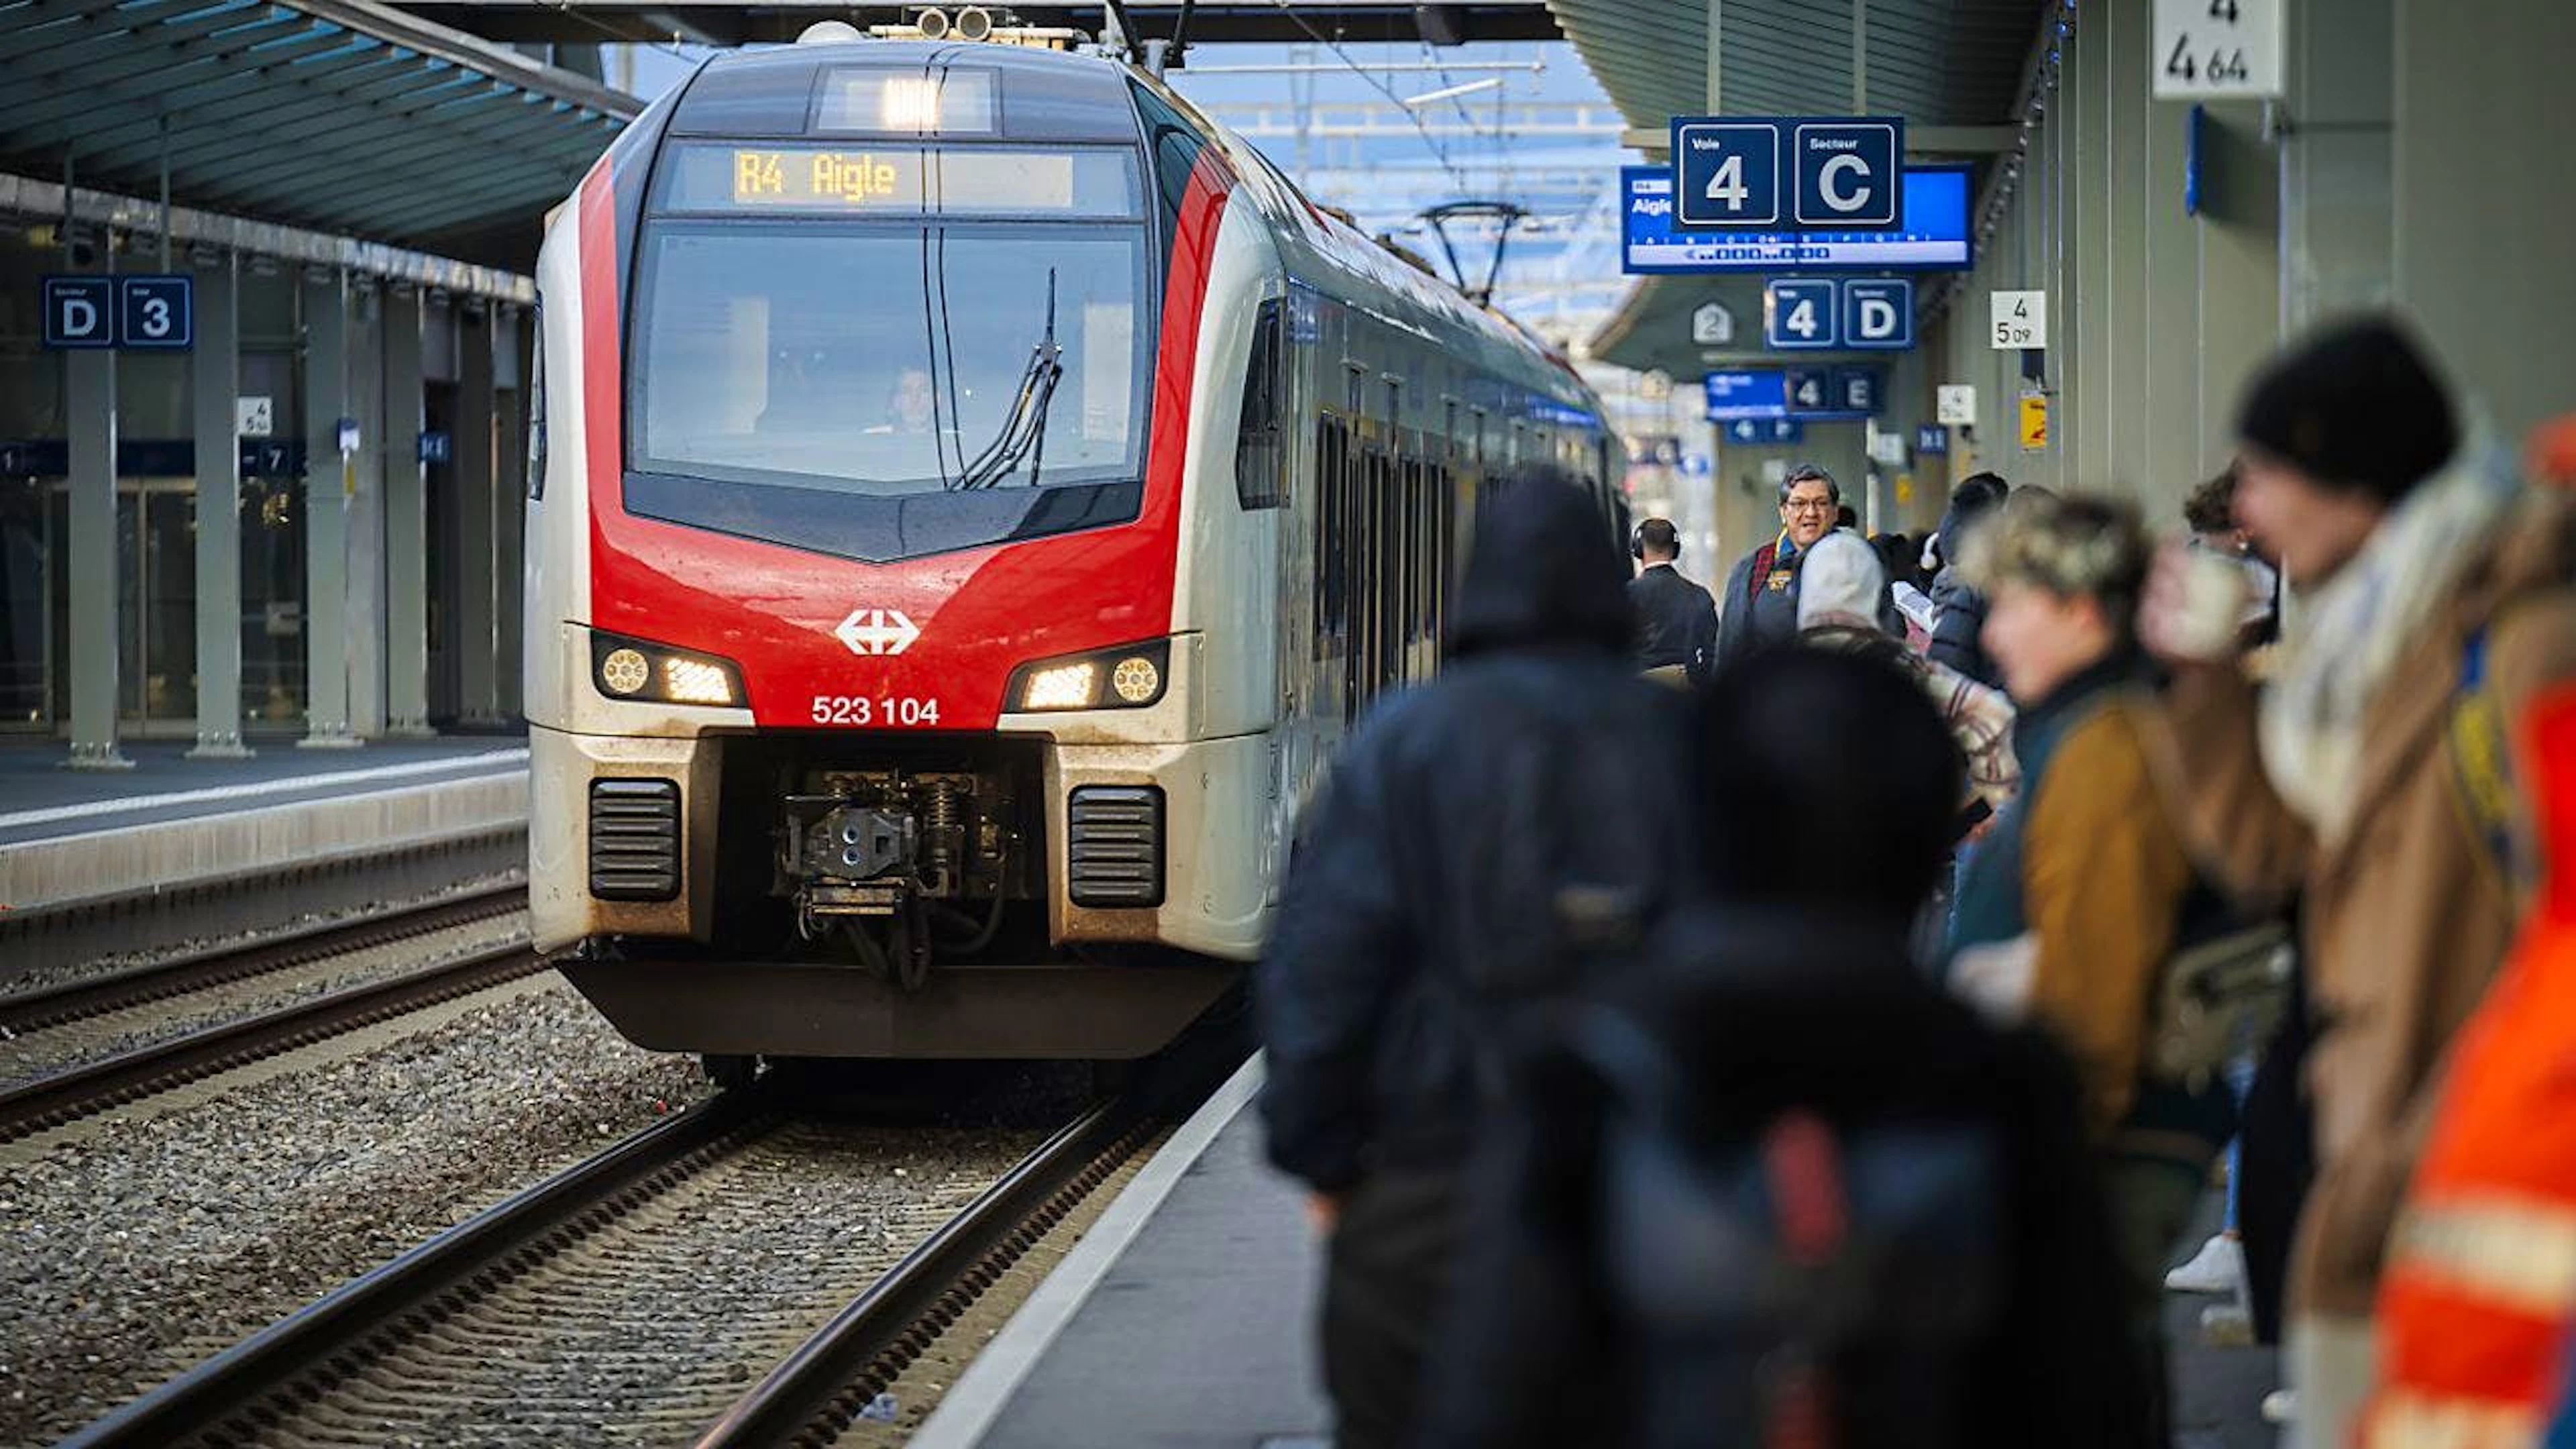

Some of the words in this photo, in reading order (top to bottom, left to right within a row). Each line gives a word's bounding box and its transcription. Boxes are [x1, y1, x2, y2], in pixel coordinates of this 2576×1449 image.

[2167, 34, 2194, 80] 4
[2207, 47, 2247, 85] 64
[1692, 138, 1721, 150] Voie
[1810, 138, 1858, 150] Secteur
[739, 153, 784, 194] R4
[813, 153, 896, 201] Aigle
[1706, 155, 1748, 211] 4
[1818, 153, 1871, 212] C
[63, 299, 97, 337] D
[142, 297, 170, 338] 3
[1786, 299, 1817, 338] 4
[1860, 299, 1897, 338] D
[2014, 298, 2027, 319] 4
[1704, 312, 1719, 336] 2
[1996, 322, 2010, 343] 5
[2012, 329, 2031, 343] 09
[1797, 379, 1821, 407] 4
[1847, 379, 1870, 407] E
[269, 449, 282, 471] 7
[812, 696, 871, 724] 523
[881, 697, 941, 726] 104
